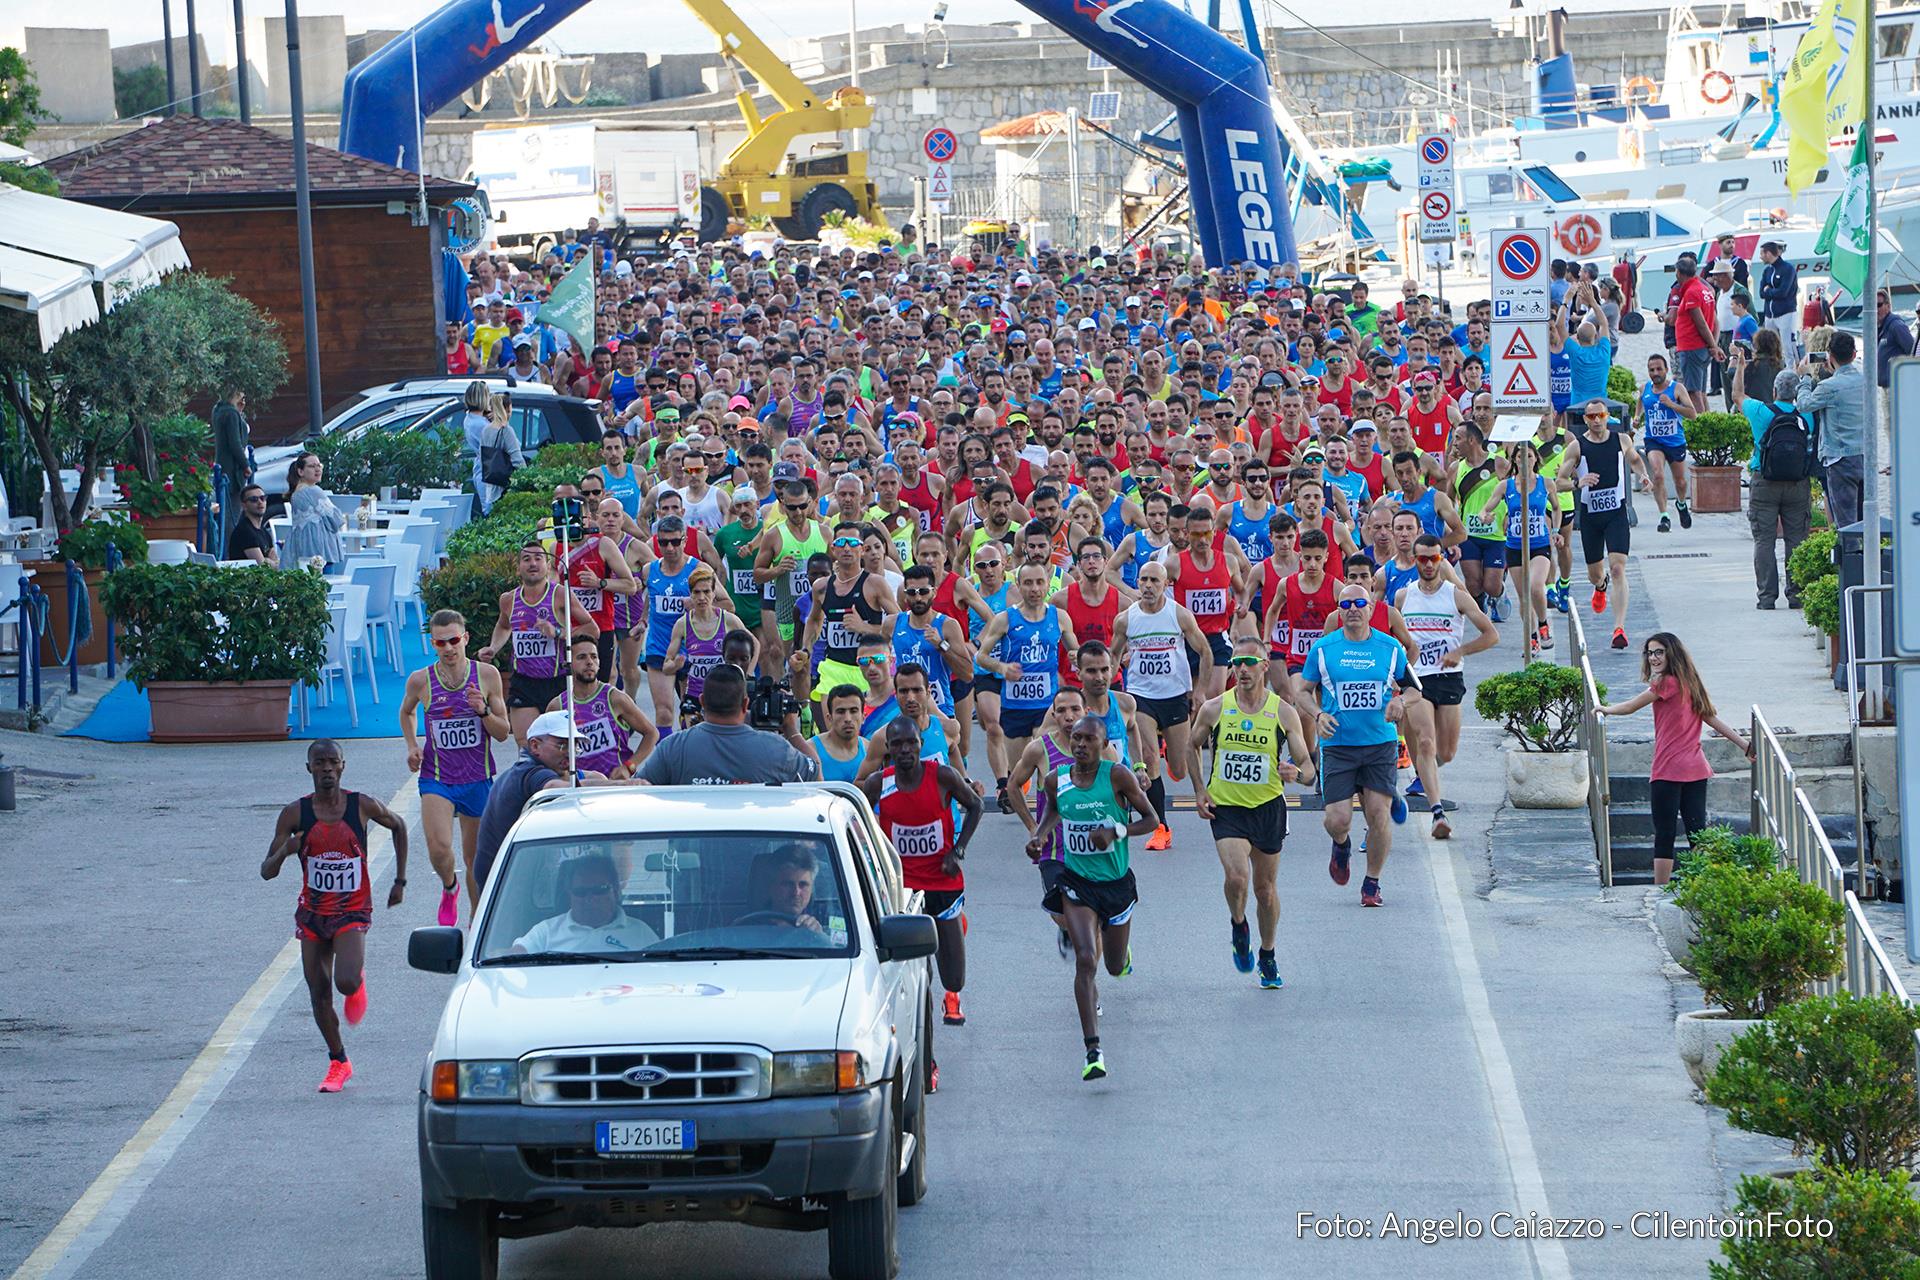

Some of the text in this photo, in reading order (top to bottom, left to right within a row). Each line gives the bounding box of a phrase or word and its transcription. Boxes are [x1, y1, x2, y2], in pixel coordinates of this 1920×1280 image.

[1225, 128, 1280, 265] LEGE
[1498, 301, 1508, 316] P
[1551, 383, 1571, 393] 0422
[1651, 425, 1675, 437] 0521
[1590, 489, 1616, 499] LEGEA
[1591, 496, 1617, 511] 0668
[1515, 523, 1541, 537] 081
[1192, 590, 1222, 598] LEGEA
[662, 597, 687, 613] 049
[1191, 599, 1222, 613] 0141
[516, 641, 548, 657] 0307
[1139, 652, 1170, 660] LEGEA
[692, 657, 723, 665] LEGEA
[1139, 661, 1172, 676] 0023
[1012, 683, 1045, 699] 0496
[1342, 683, 1376, 691] LEGEA
[1342, 692, 1377, 709] 0255
[438, 719, 475, 730] LEGEA
[440, 728, 477, 748] 0005
[1224, 733, 1268, 745] AIELLO
[1224, 753, 1262, 763] LEGEA
[1224, 762, 1262, 782] 0545
[897, 825, 936, 837] LEGEA
[898, 834, 938, 854] 0006
[314, 861, 354, 871] LEGEA
[314, 871, 355, 890] 0011
[634, 1071, 657, 1081] Ford
